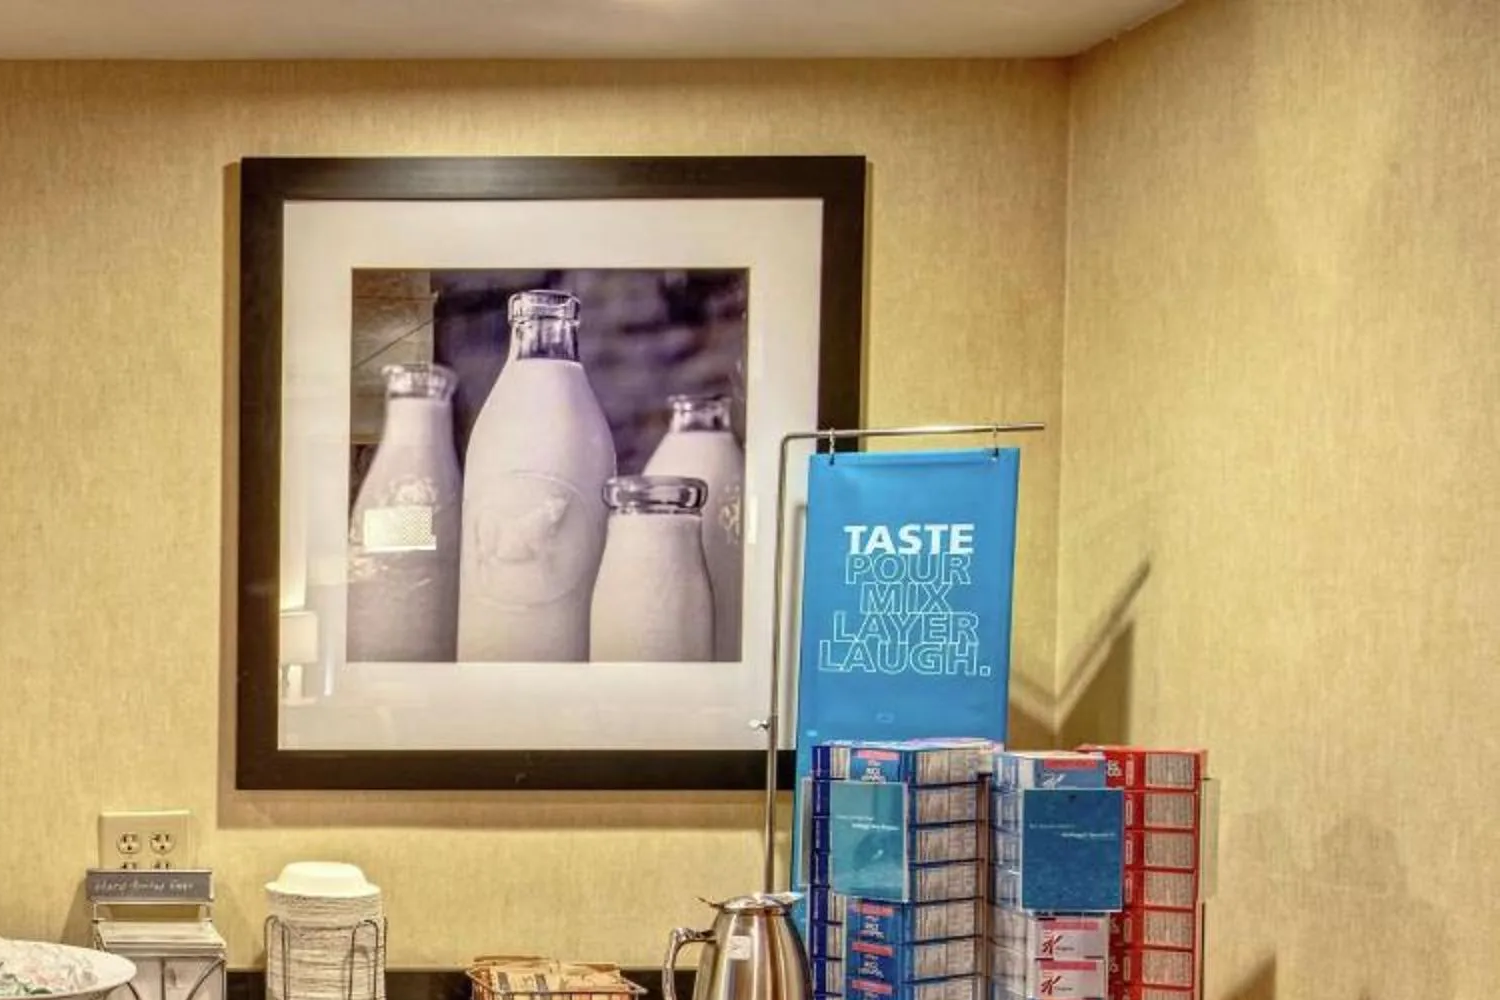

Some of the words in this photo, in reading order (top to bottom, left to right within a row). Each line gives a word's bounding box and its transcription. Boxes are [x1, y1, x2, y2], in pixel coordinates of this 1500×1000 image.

[843, 523, 975, 555] TASTE
[845, 552, 972, 585] POUR
[860, 582, 951, 615] MIX
[833, 611, 979, 645] LAYER
[819, 639, 991, 676] LAUGH.
